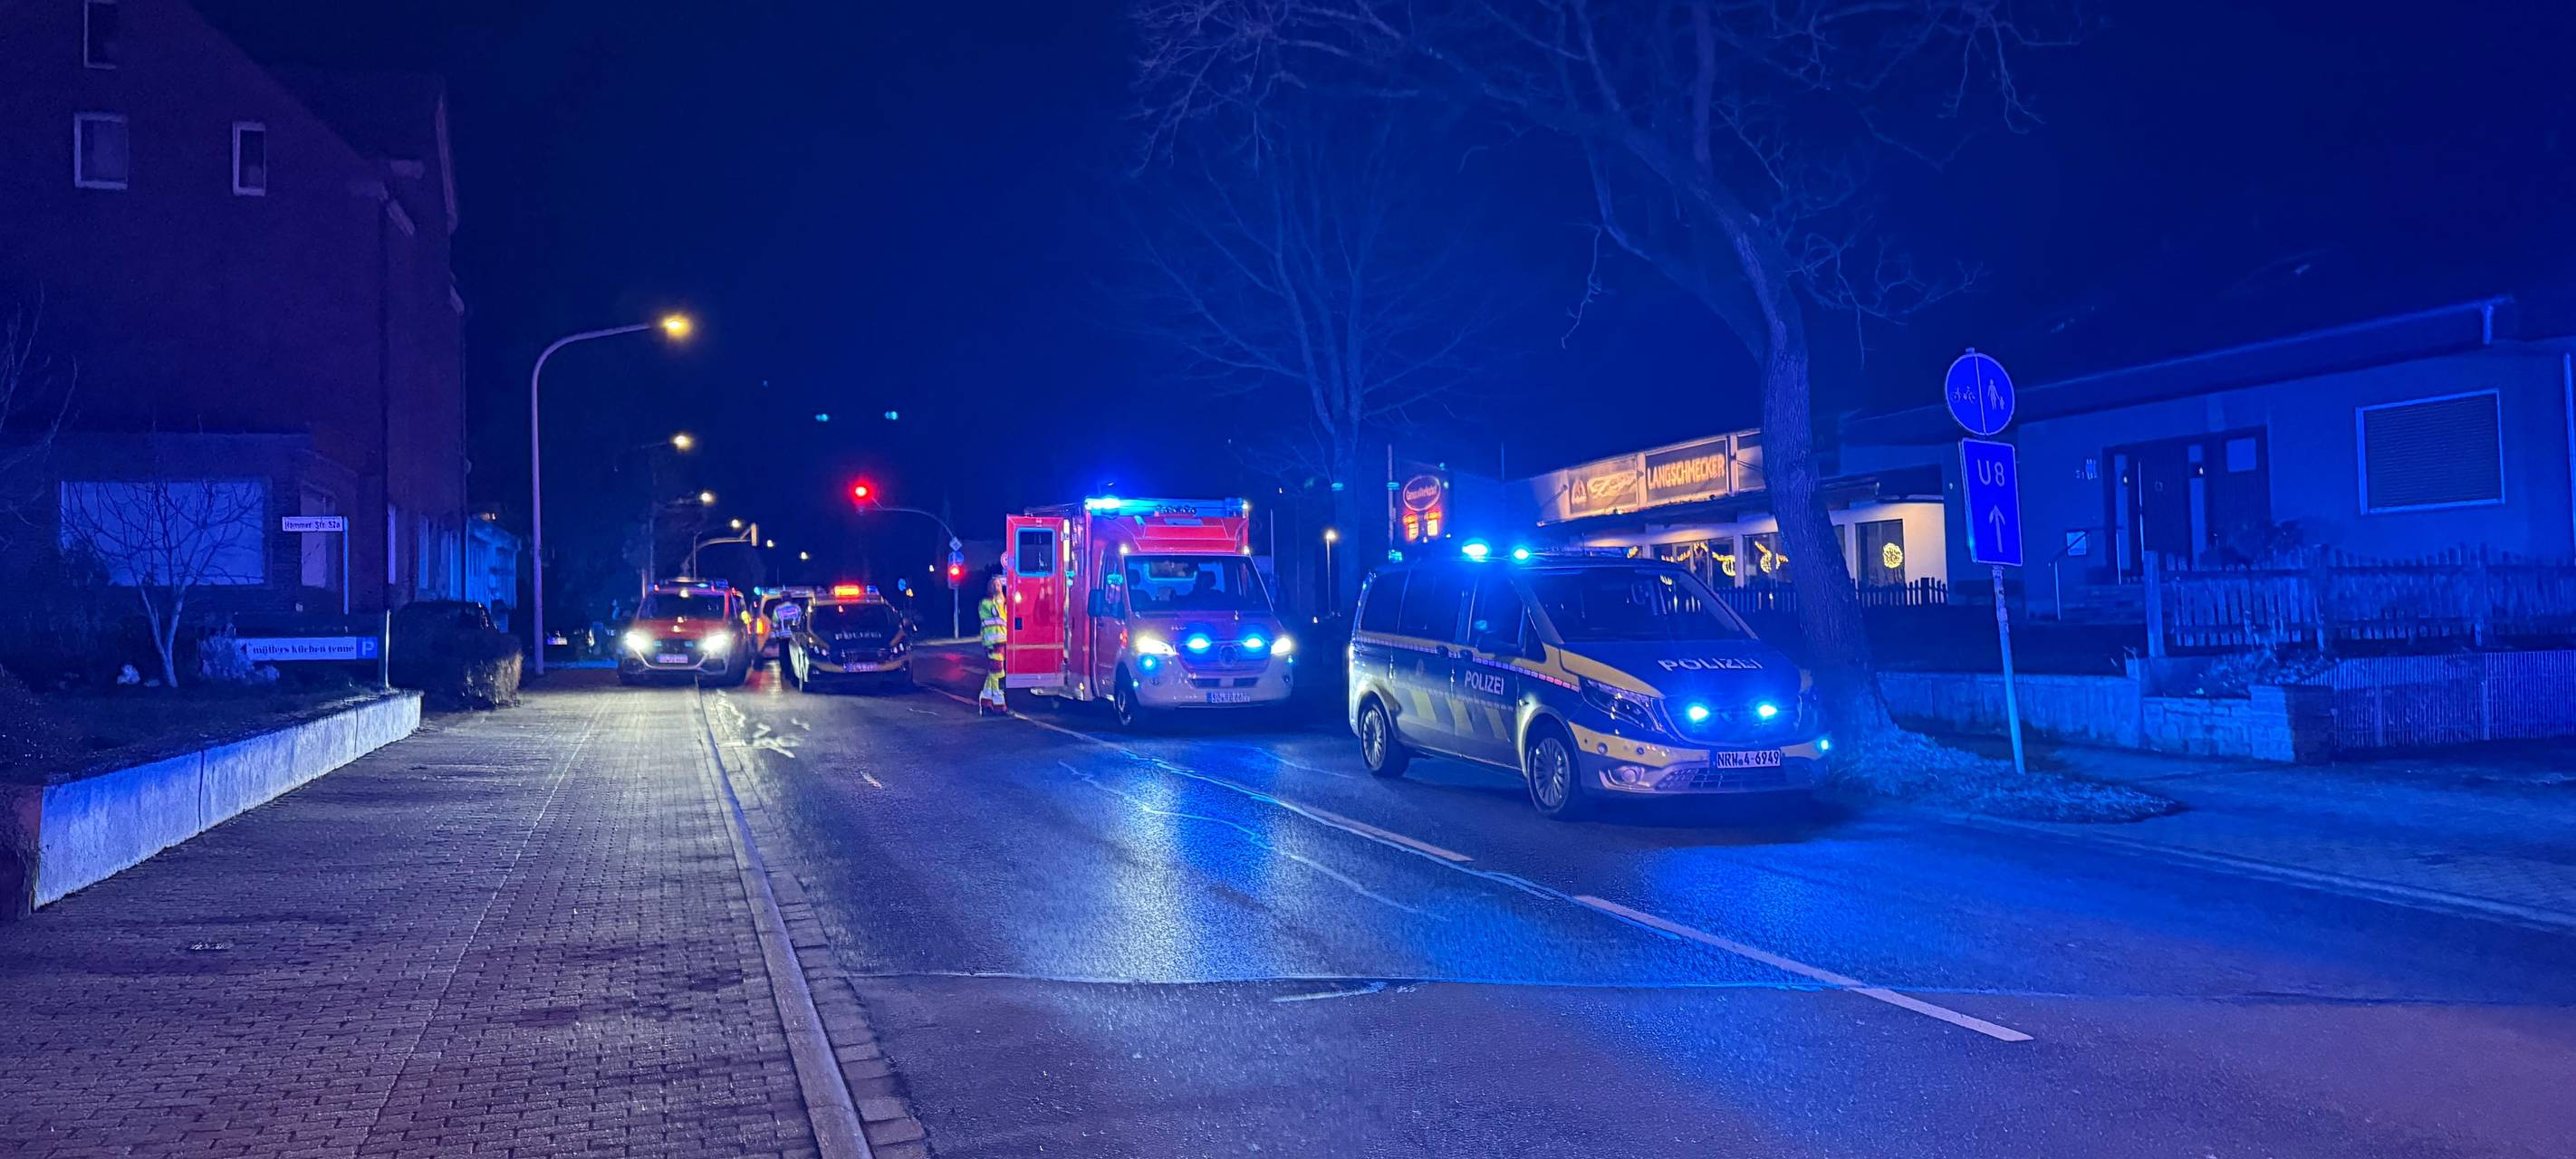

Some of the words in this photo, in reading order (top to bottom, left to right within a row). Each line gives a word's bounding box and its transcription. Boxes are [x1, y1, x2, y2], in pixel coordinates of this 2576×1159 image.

[1647, 454, 1725, 490] LANGSCHMECKER
[1657, 657, 1764, 672] POLIZEI
[1464, 669, 1504, 696] POLIZEI
[1744, 751, 1780, 766] 4-6949
